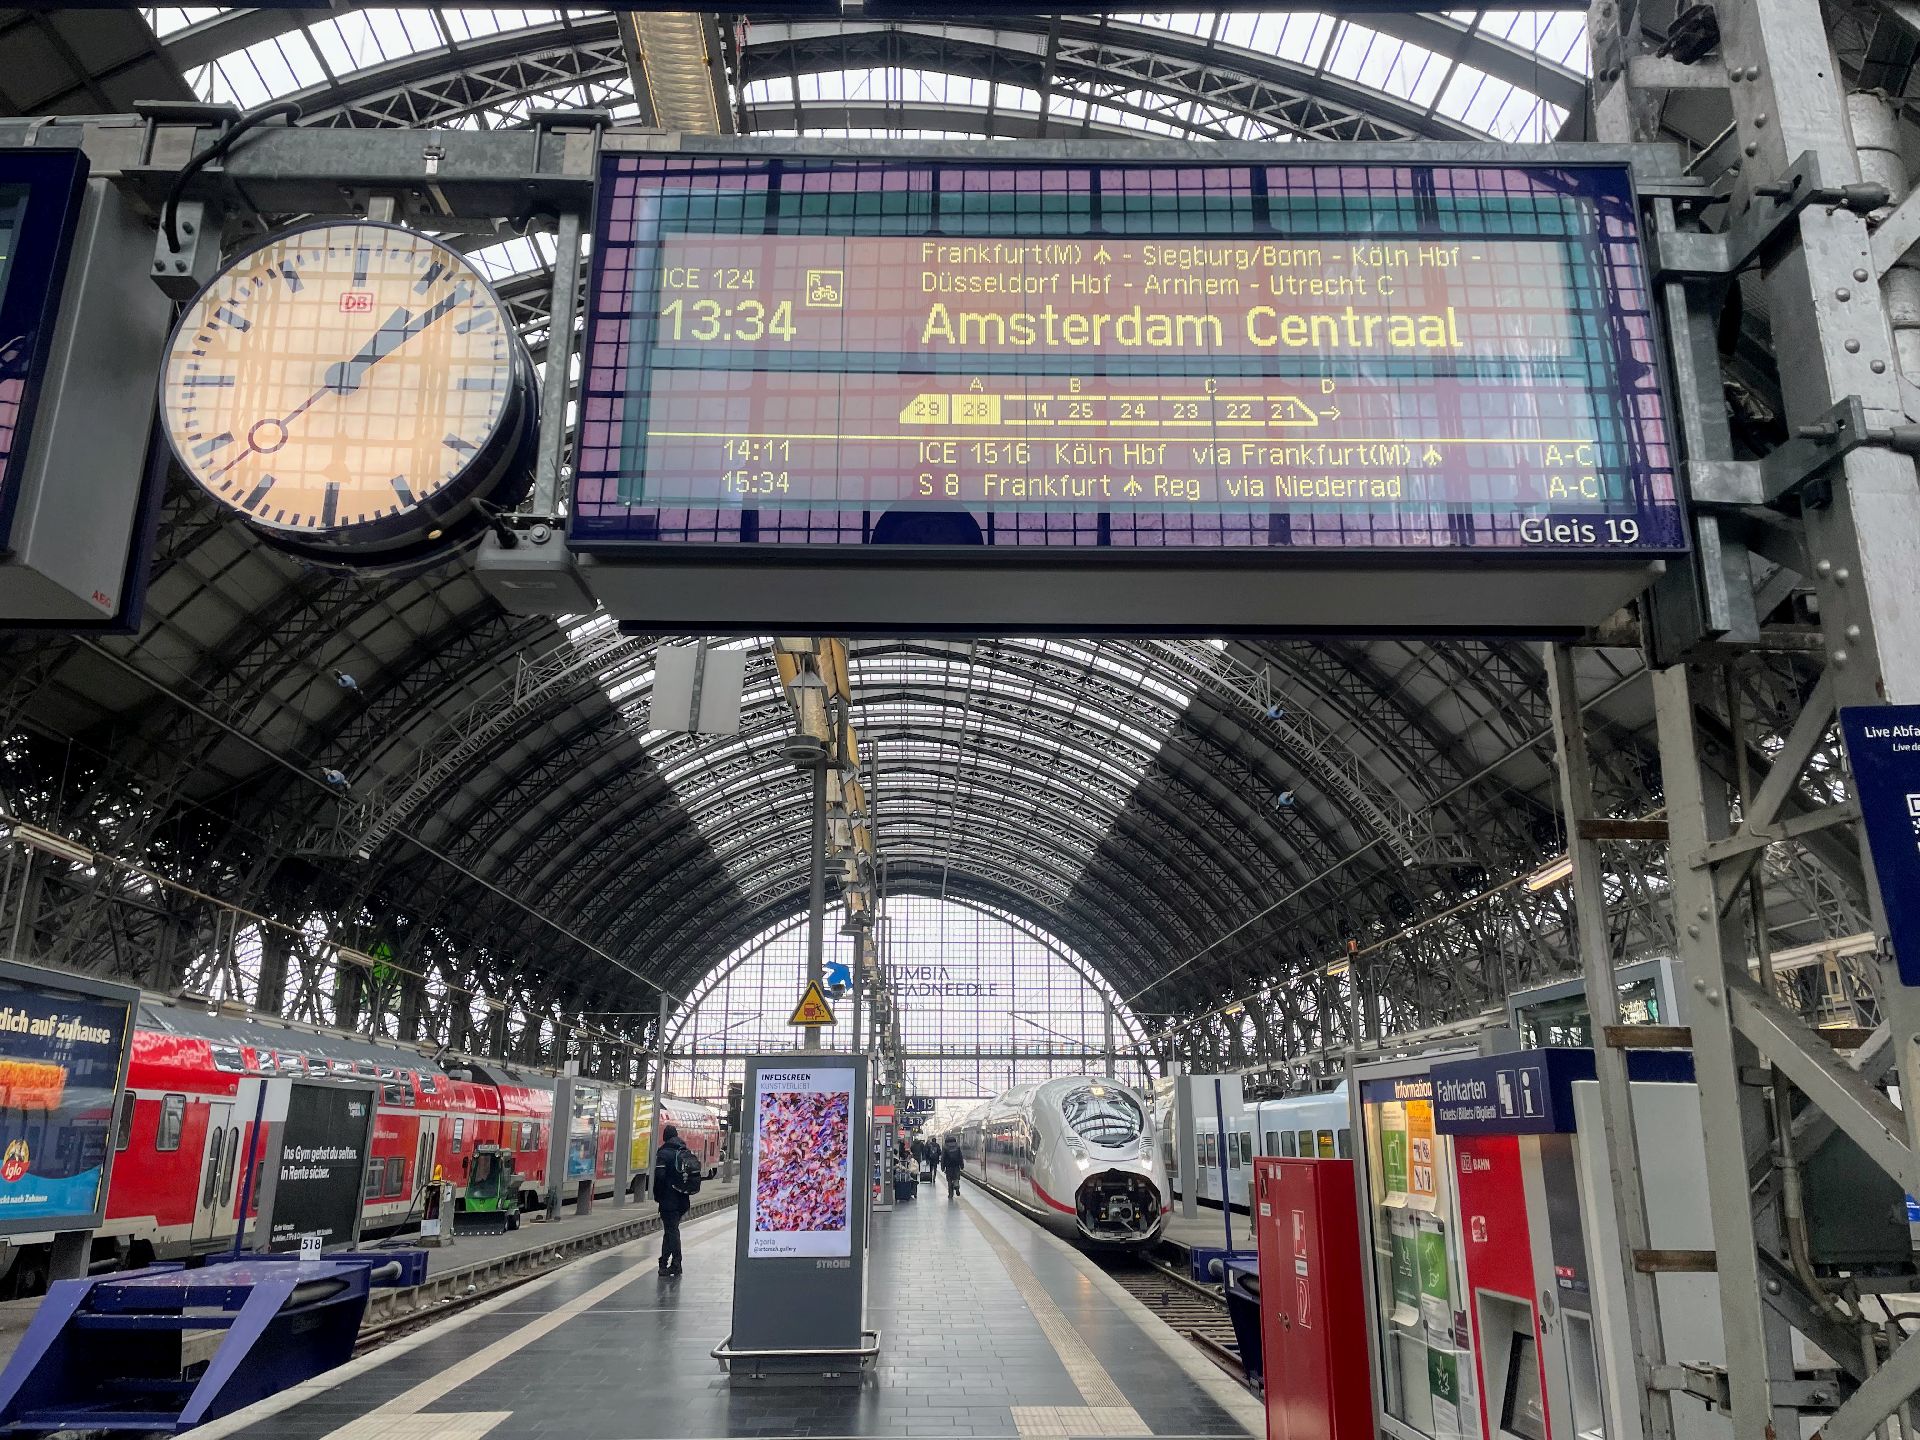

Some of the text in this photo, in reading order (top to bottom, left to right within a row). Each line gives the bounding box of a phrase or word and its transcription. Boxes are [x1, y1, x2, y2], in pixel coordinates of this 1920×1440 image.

[922, 242, 1082, 265] Frankfurt(M)
[1143, 245, 1322, 270] Siegburg/Bonn
[1352, 246, 1409, 267] Köln
[1418, 246, 1460, 267] Hbf
[663, 268, 754, 290] ICE 124
[922, 271, 1060, 294] Düsseldorf
[1071, 273, 1112, 295] Hbf
[1144, 274, 1240, 296] Arnhem
[1270, 274, 1367, 296] Utrecht
[1377, 275, 1394, 296] C
[345, 296, 367, 310] DB
[661, 299, 797, 341] 13:34
[921, 302, 1464, 348] Amsterdam Centraal
[969, 376, 984, 392] A
[1070, 378, 1081, 393] B
[1205, 378, 1217, 394] C
[1321, 379, 1335, 394] D
[914, 401, 940, 417] 29
[962, 402, 988, 417] 28
[1068, 403, 1094, 418] 25
[1120, 403, 1146, 419] 24
[1173, 403, 1199, 419] 23
[1226, 404, 1252, 419] 22
[1271, 404, 1295, 419] 21
[723, 439, 790, 462] 14:11
[919, 442, 1412, 466] ICE 1516 Köln Hbf via Frankfurt(M)
[1545, 444, 1593, 467] A-C
[722, 470, 790, 494] 15:34
[919, 473, 1402, 501] S 8 Frankfurt Reg via Niederrad
[1549, 476, 1598, 498] A-C
[1520, 518, 1640, 544] Gleis 19
[1864, 725, 1920, 738] Live Abfa
[0, 1007, 111, 1045] dich auf zuhause
[1395, 1079, 1433, 1099] Information
[1437, 1078, 1487, 1103] Fahrkarten
[906, 1098, 934, 1110] A 19
[283, 1144, 295, 1160] Ins
[295, 1145, 311, 1163] Gym
[311, 1145, 330, 1163] gehst
[6, 1162, 22, 1180] iglo
[280, 1165, 289, 1180] In
[289, 1165, 310, 1180] Rente
[1473, 1158, 1491, 1171] BAHN
[302, 1239, 321, 1250] 518
